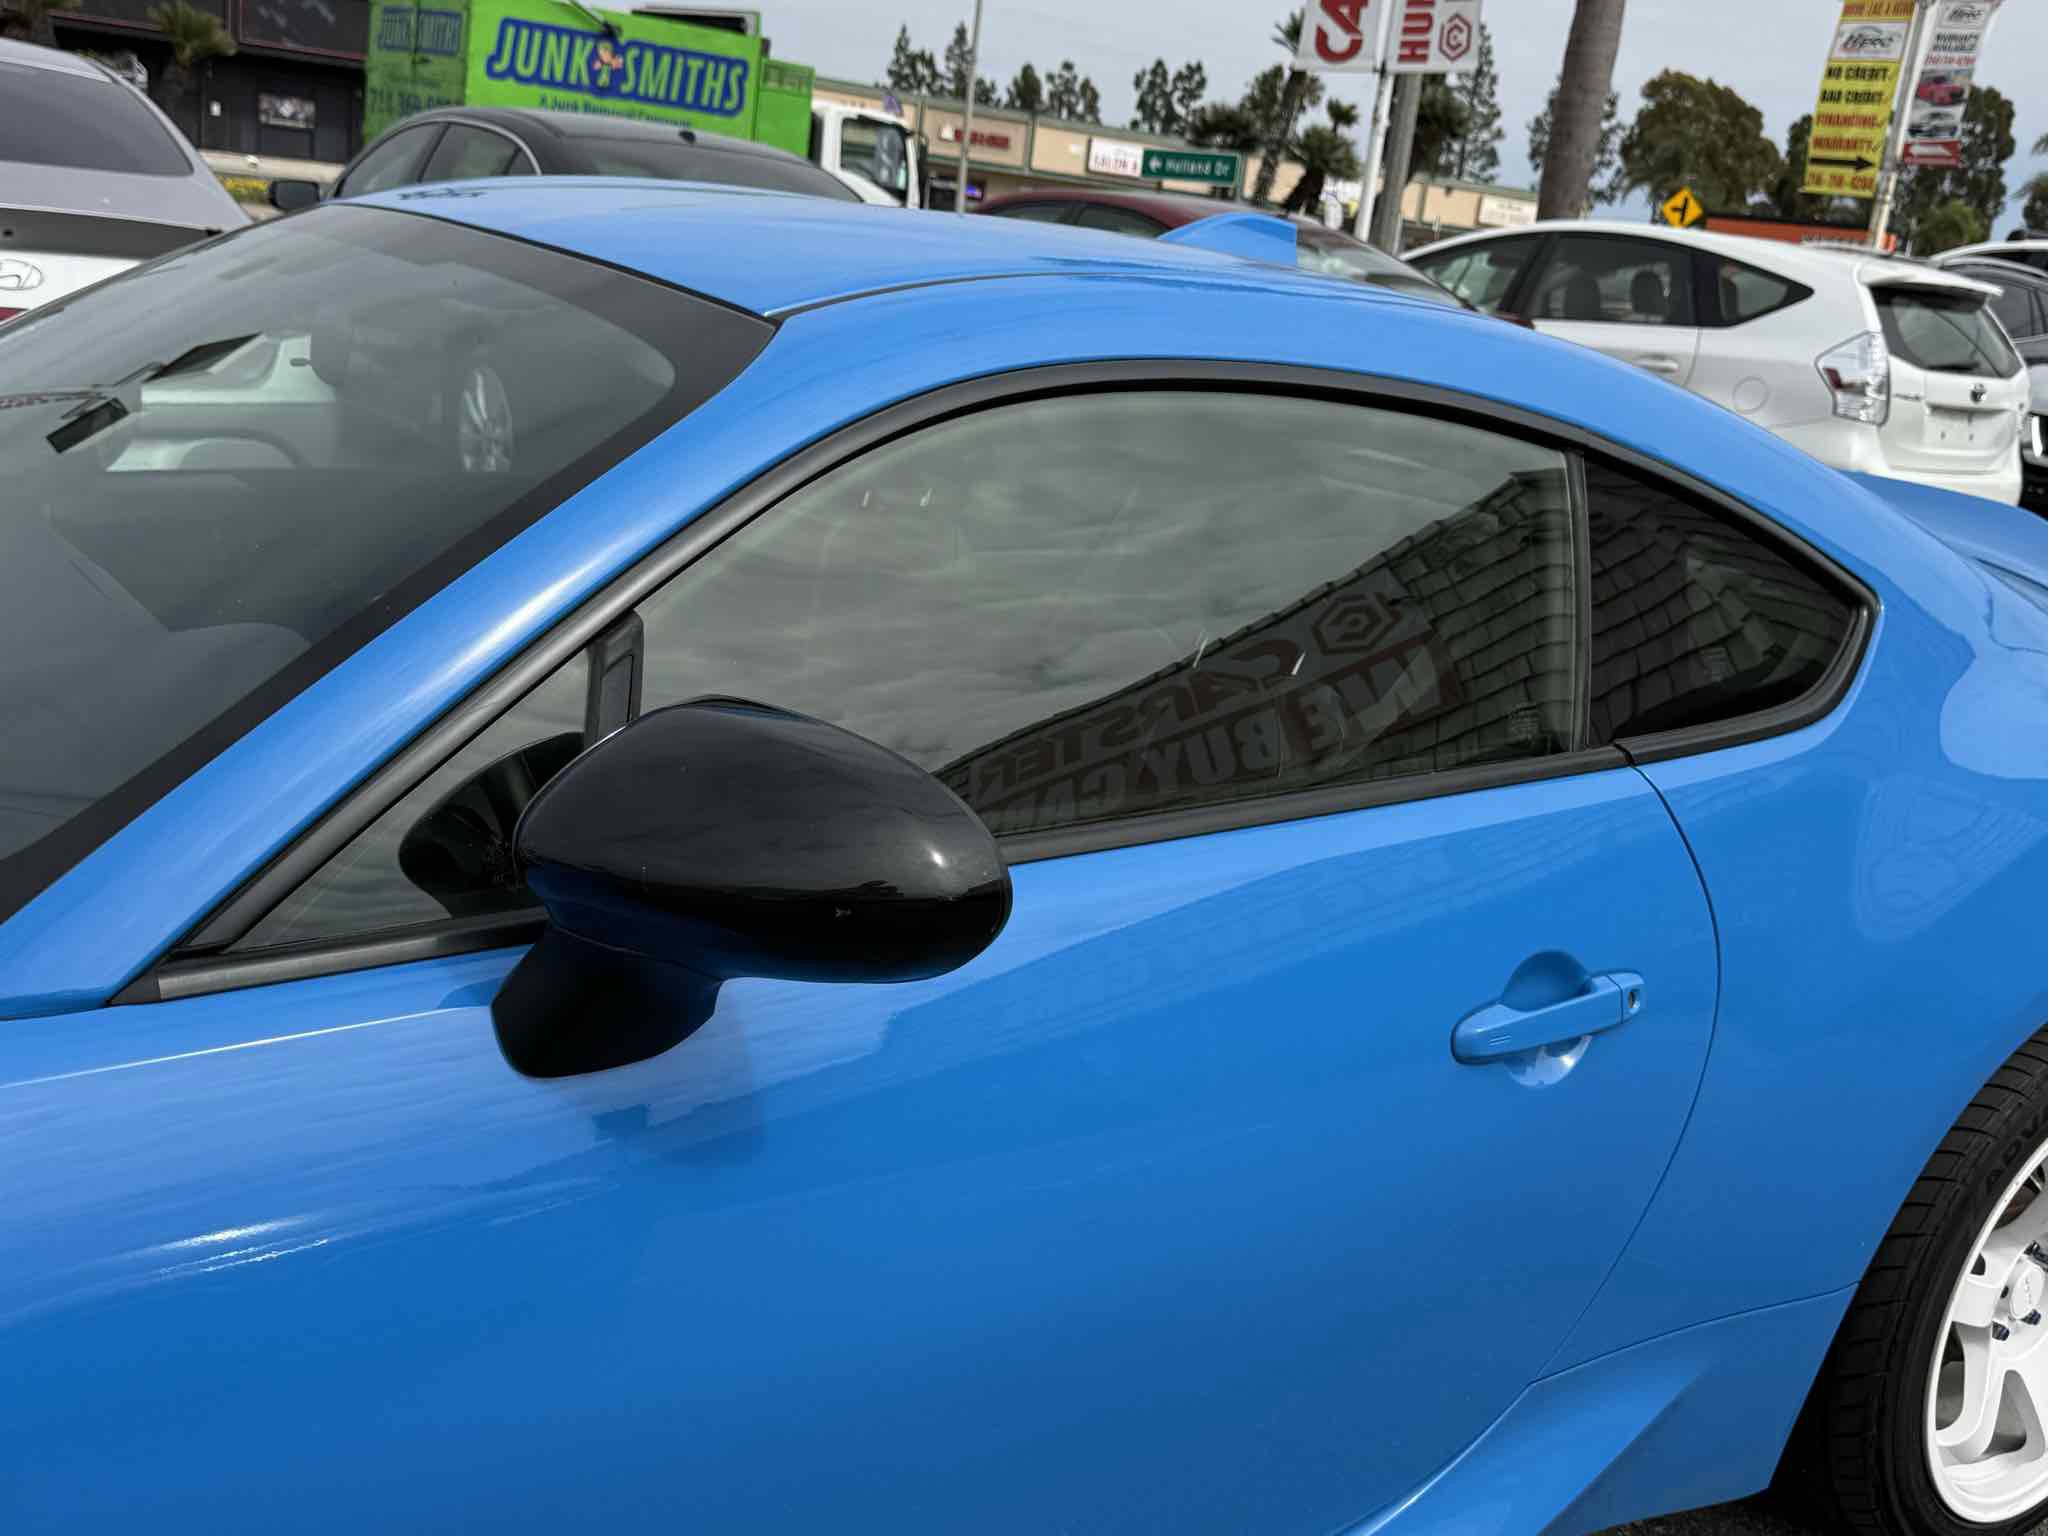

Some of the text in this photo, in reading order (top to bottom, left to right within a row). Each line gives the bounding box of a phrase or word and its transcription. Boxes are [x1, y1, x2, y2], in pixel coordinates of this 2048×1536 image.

[1397, 0, 1436, 63] HU
[493, 24, 743, 111] JUNK SMITHS
[1845, 65, 1889, 81] CREDIT
[551, 96, 578, 112] Junk
[1844, 90, 1884, 105] CREDIT
[1165, 157, 1230, 176] Holland Dr
